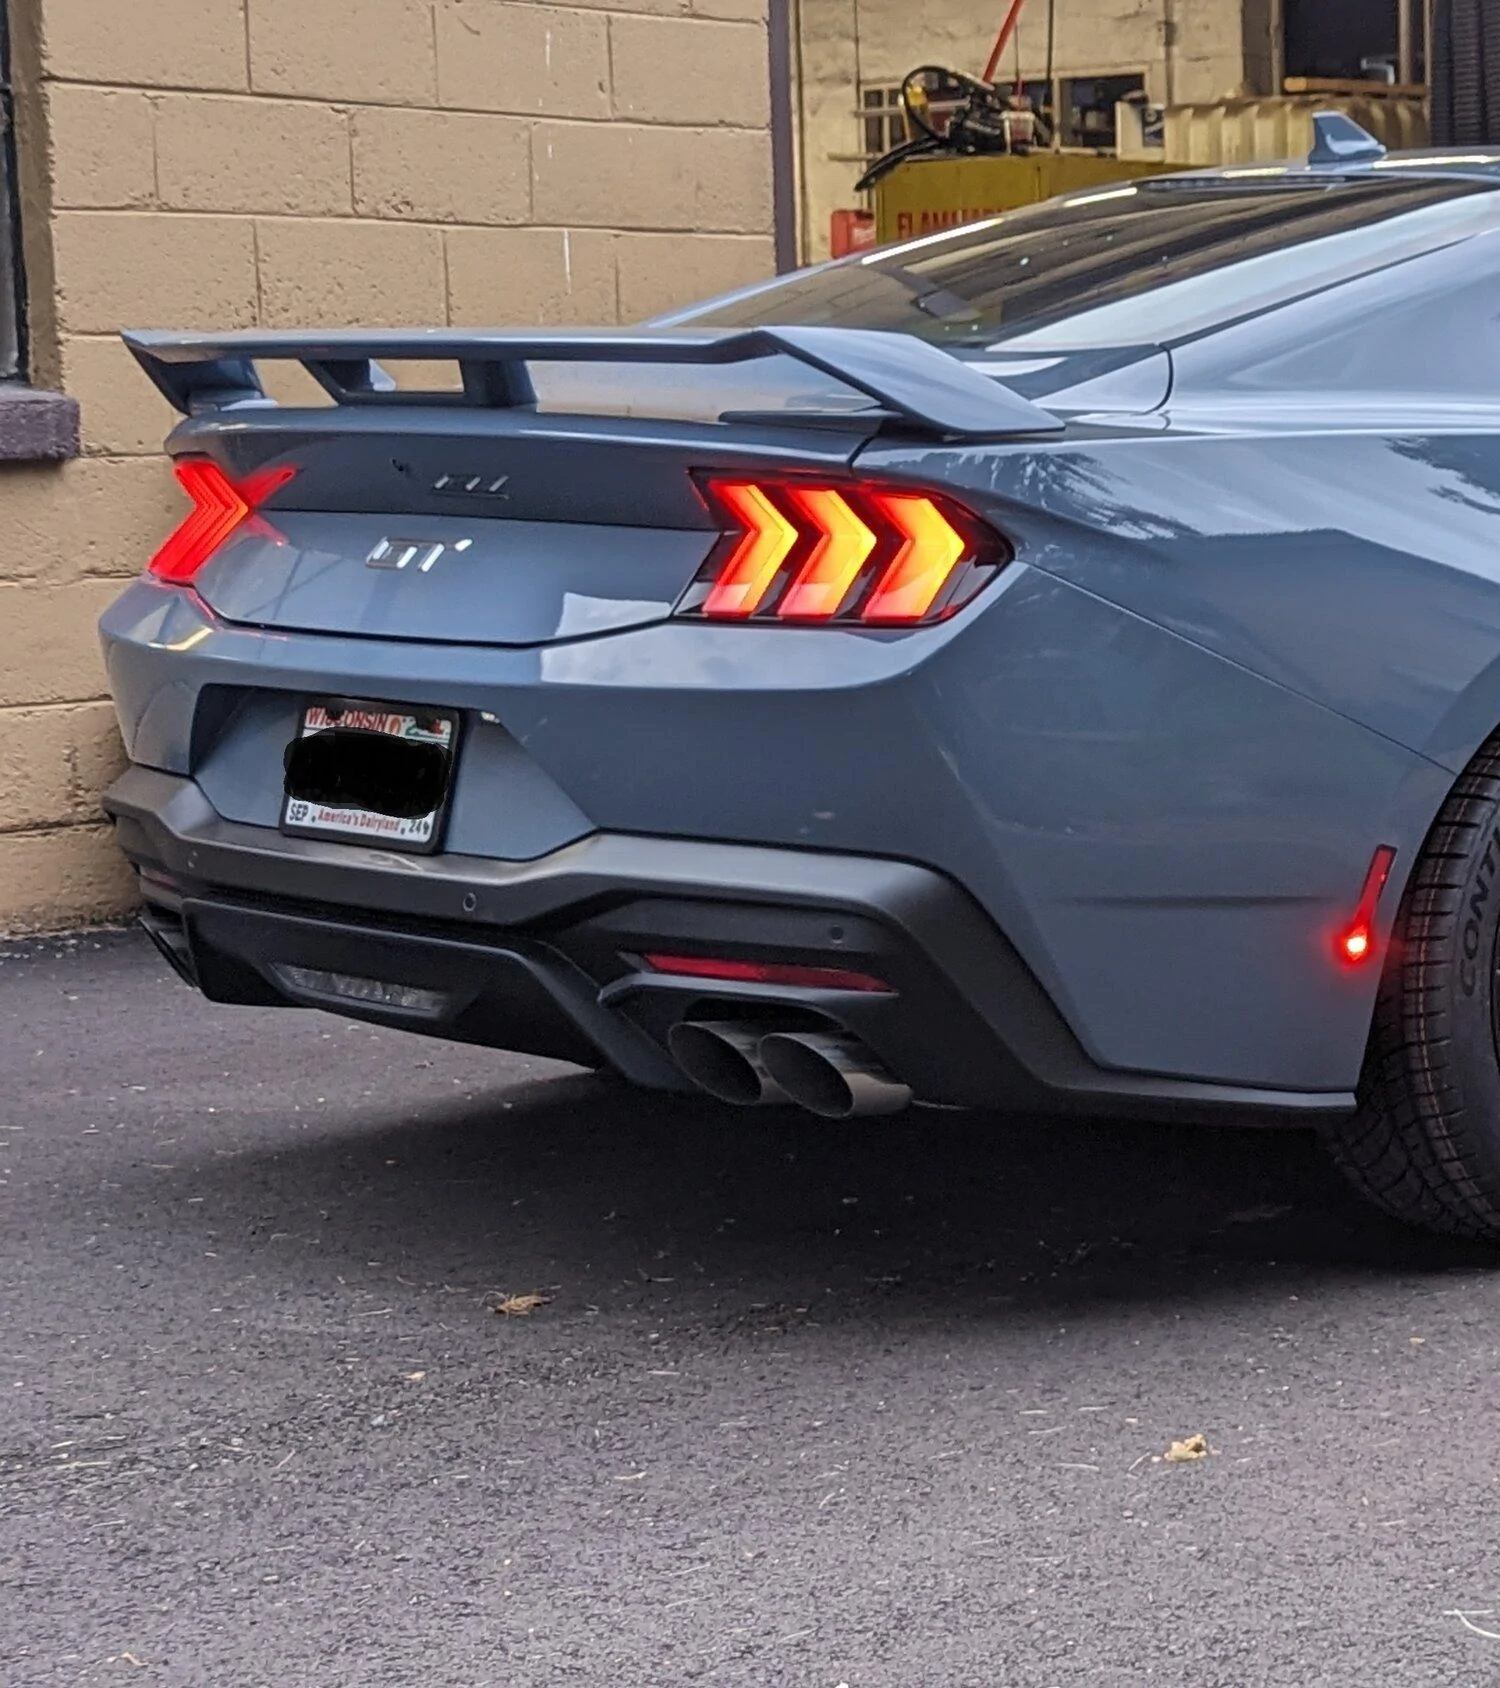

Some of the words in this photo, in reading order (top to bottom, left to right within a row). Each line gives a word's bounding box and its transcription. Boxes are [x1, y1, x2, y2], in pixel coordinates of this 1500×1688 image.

[290, 802, 309, 821] SEP
[318, 809, 358, 826] America's
[360, 813, 400, 832] Dairyland
